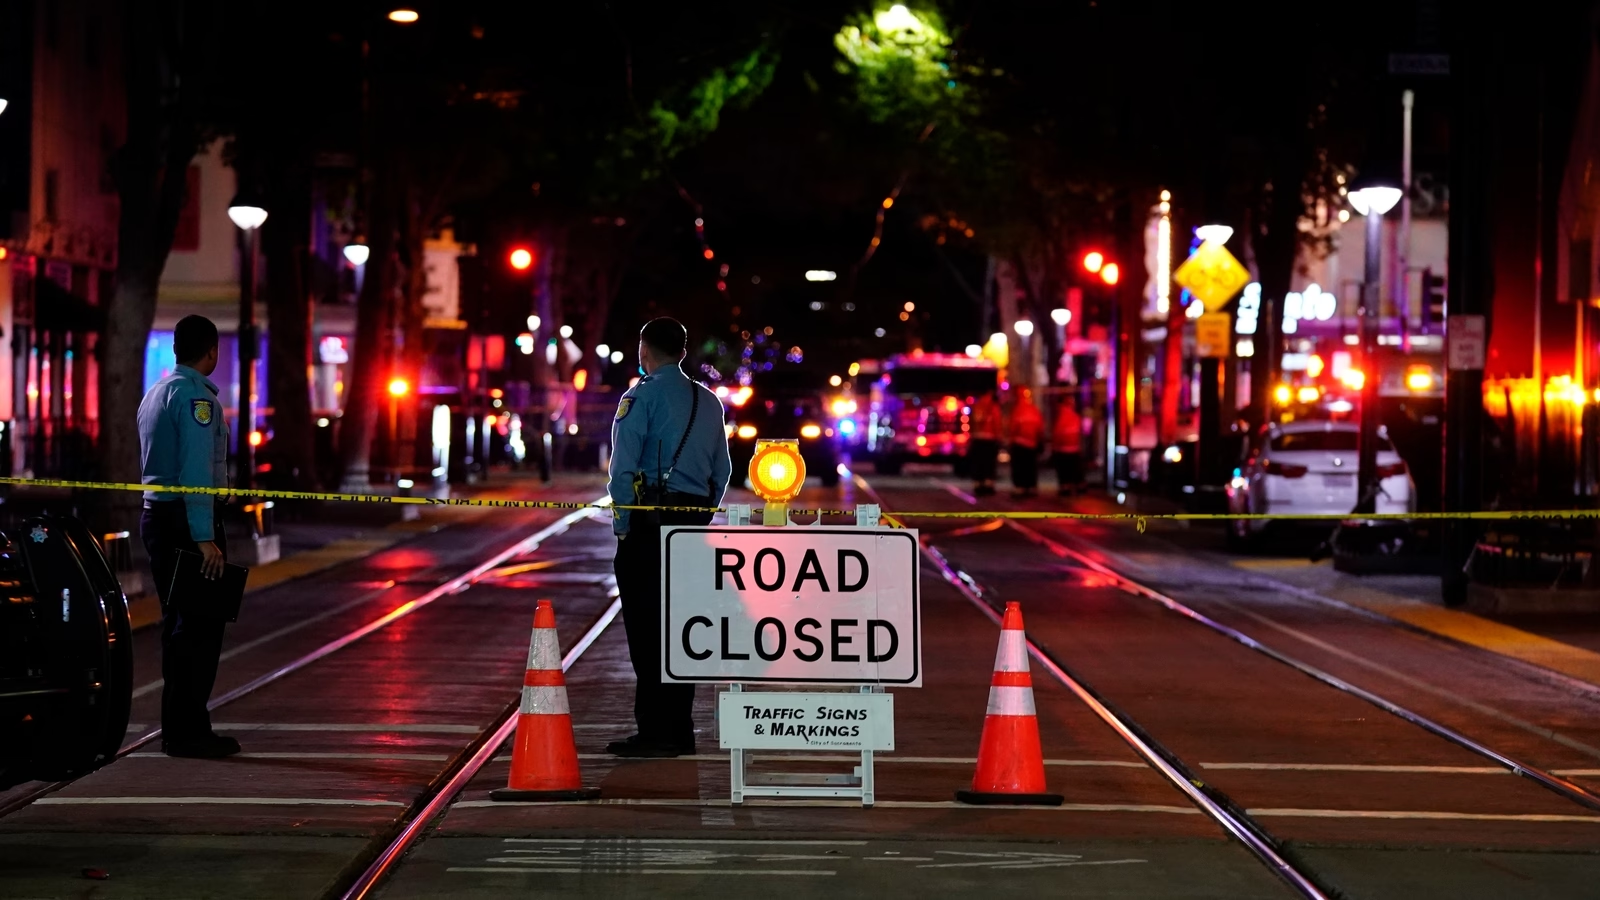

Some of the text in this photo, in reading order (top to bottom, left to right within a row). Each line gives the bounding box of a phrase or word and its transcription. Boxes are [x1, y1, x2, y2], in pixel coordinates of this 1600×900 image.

[715, 547, 869, 592] ROAD
[681, 615, 899, 663] CLOSED
[754, 723, 765, 735] &
